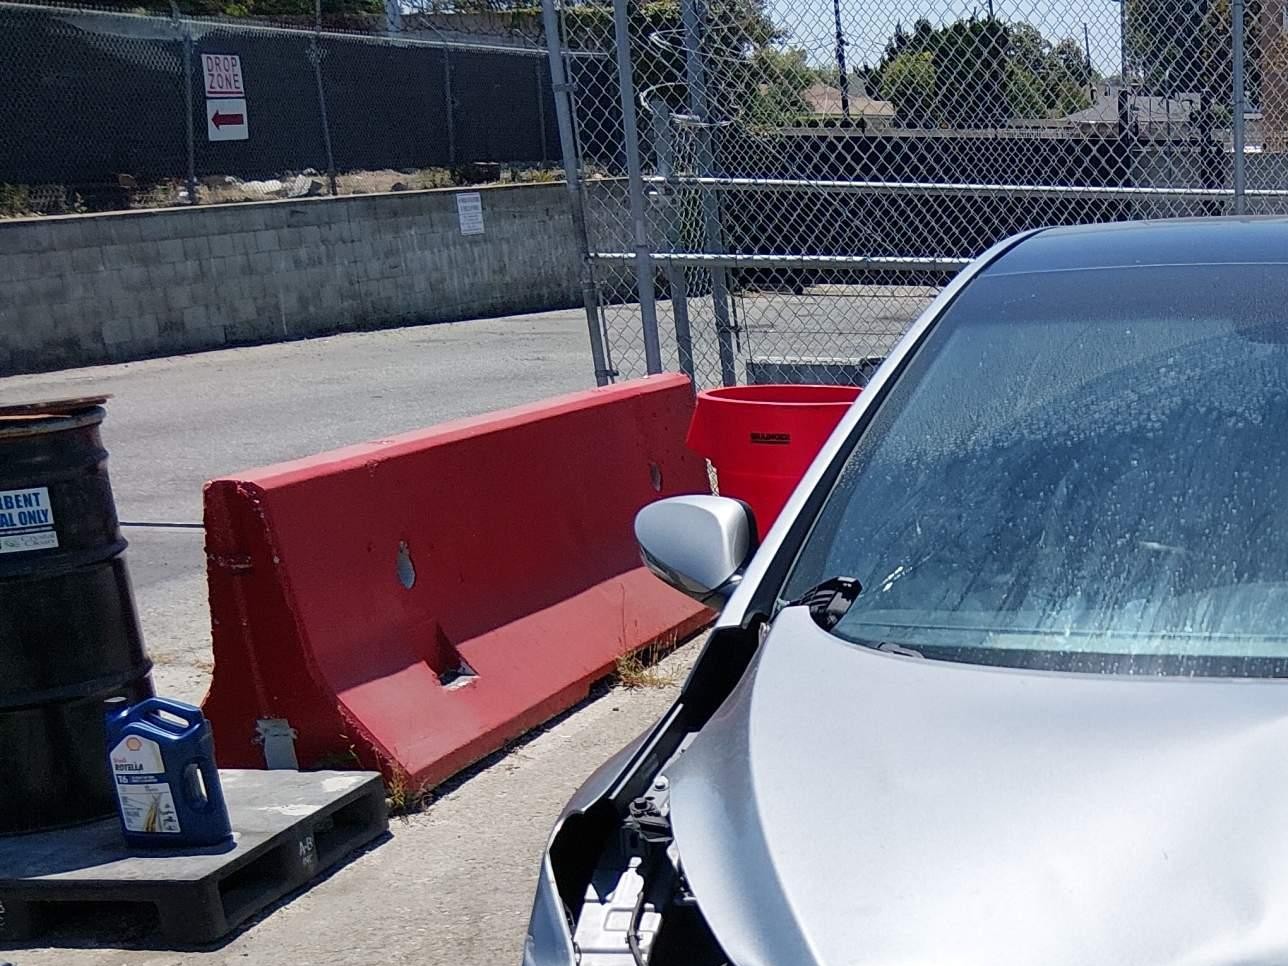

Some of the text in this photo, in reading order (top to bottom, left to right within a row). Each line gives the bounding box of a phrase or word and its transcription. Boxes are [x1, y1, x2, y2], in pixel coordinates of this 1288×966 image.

[206, 55, 237, 72] DROP
[208, 73, 241, 89] ZONE
[18, 509, 49, 525] ONLY
[118, 775, 129, 784] T6
